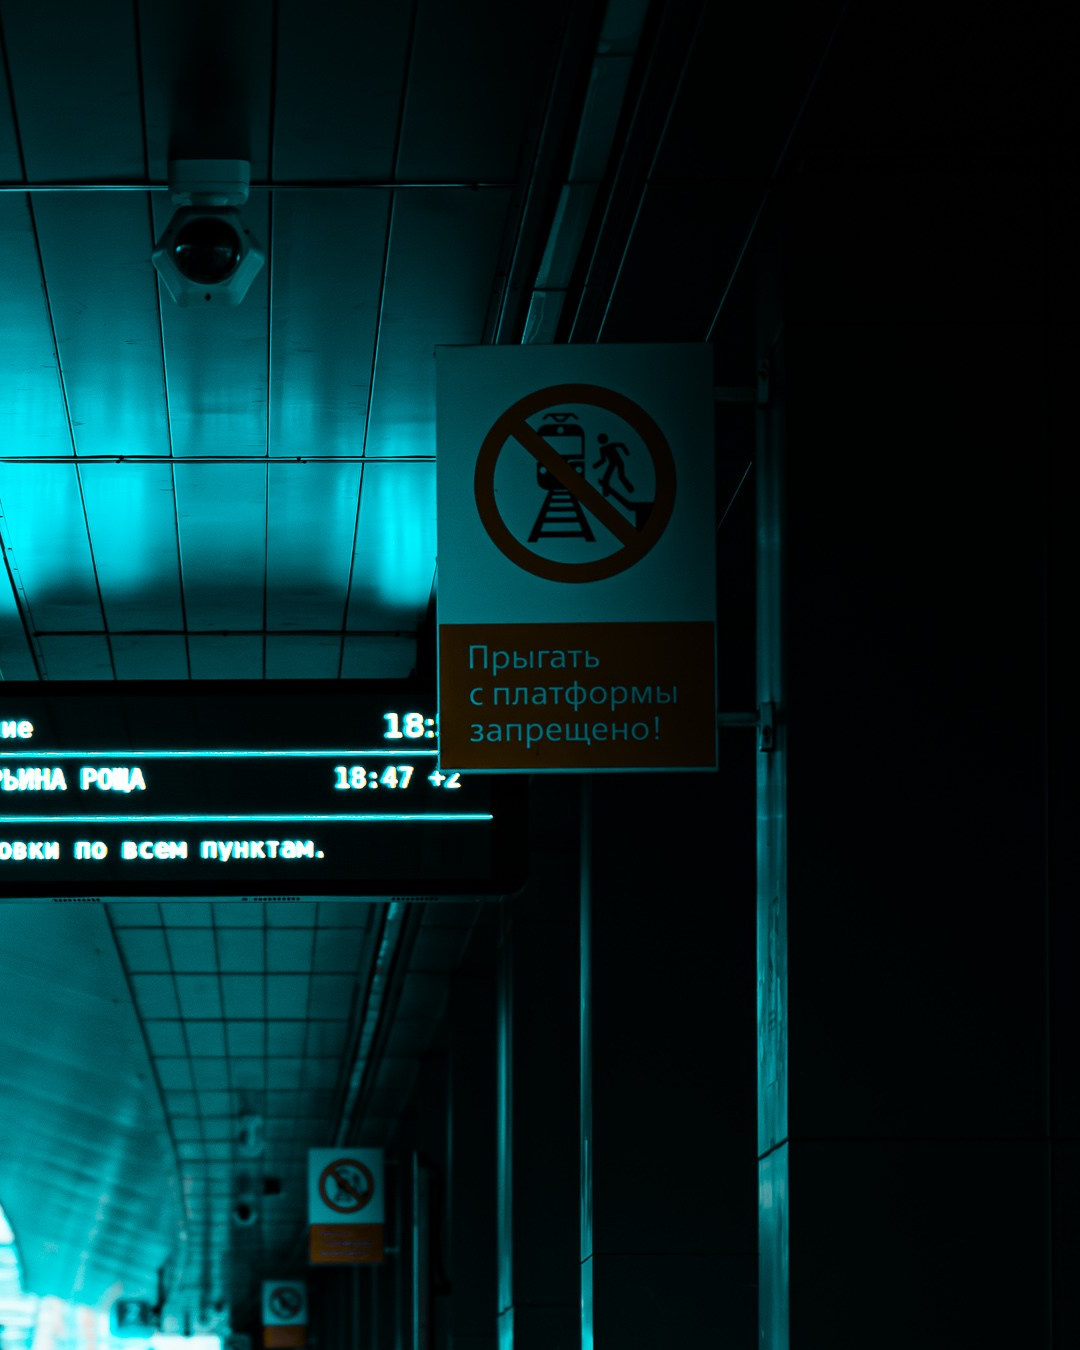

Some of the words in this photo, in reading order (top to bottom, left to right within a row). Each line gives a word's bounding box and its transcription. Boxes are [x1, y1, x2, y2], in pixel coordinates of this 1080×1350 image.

[469, 644, 600, 676] Прыгать
[469, 686, 484, 706] с
[493, 680, 678, 712] платформы
[470, 716, 660, 749] запрещено!
[80, 767, 147, 793] РОЩА
[333, 765, 414, 791] 18:47
[74, 840, 108, 861] по
[121, 840, 188, 861] всем
[200, 839, 325, 863] пунктам.
